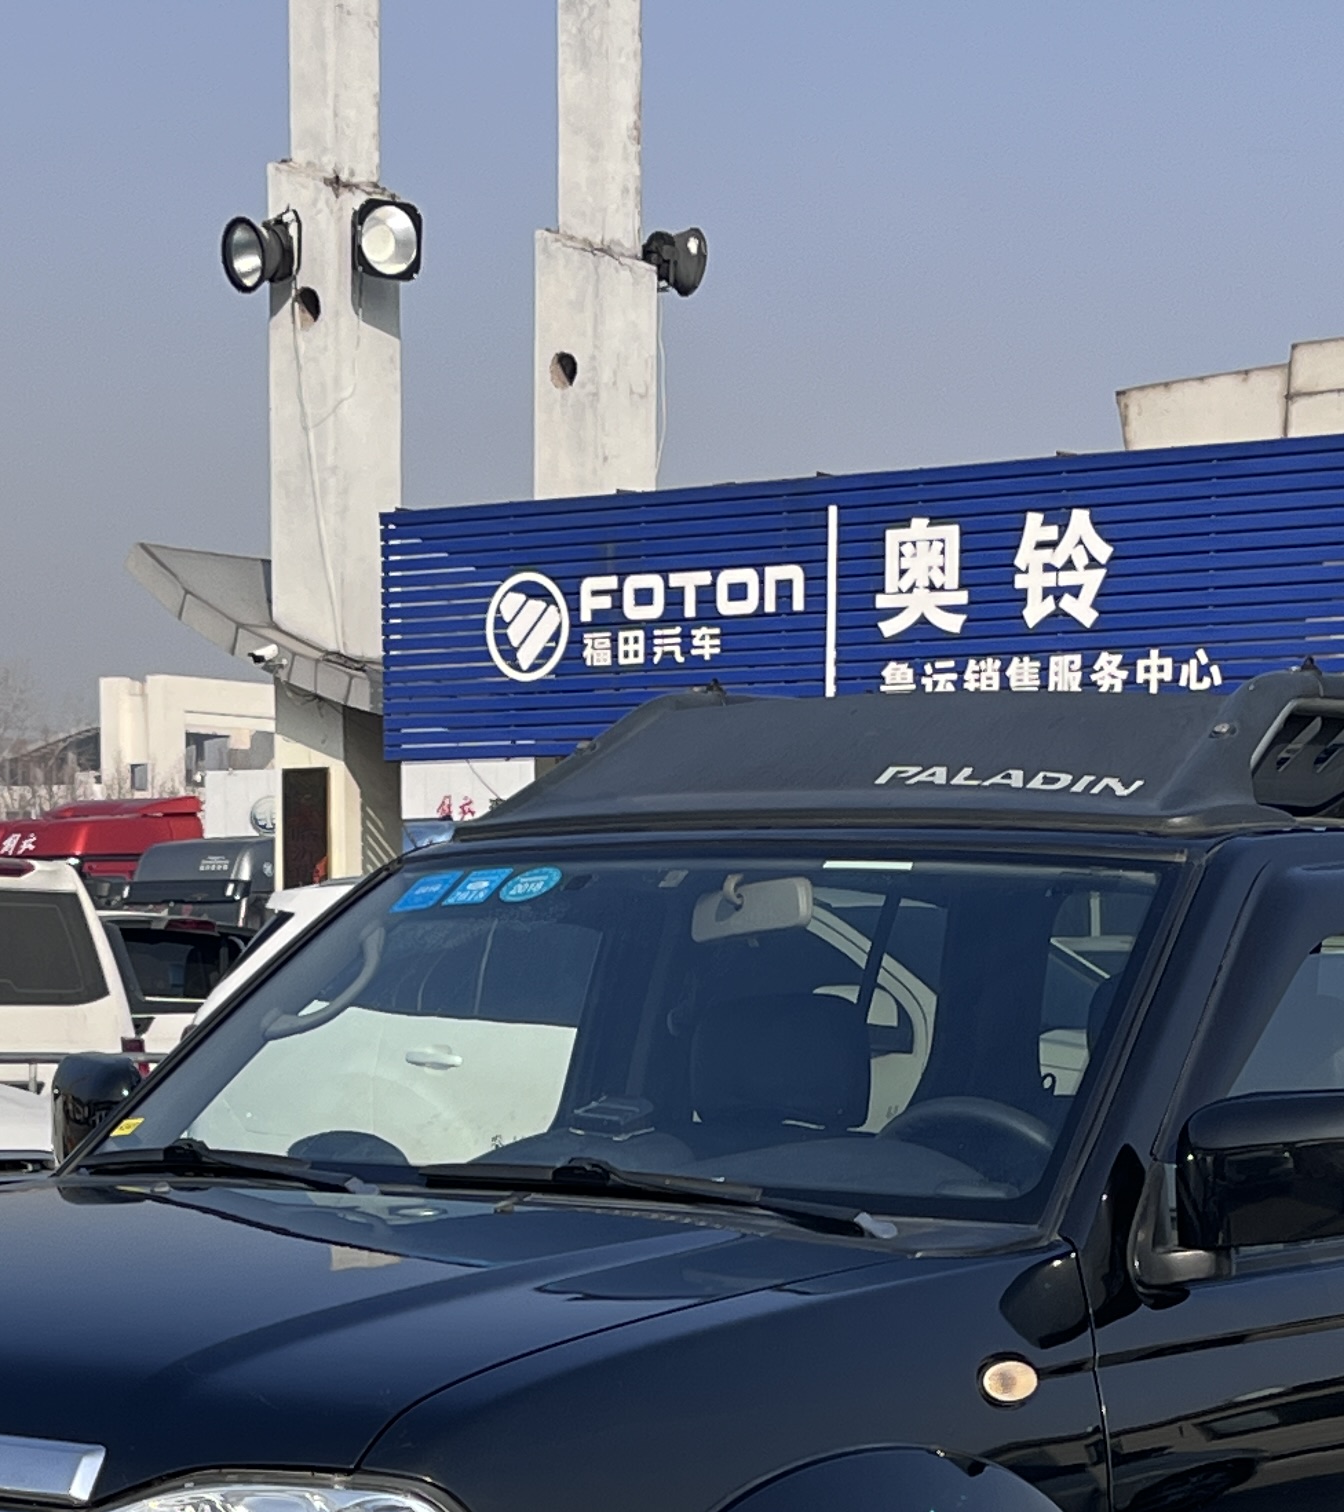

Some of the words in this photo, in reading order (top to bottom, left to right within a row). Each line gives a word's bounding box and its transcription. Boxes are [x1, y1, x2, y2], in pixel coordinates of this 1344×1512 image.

[579, 565, 805, 623] FOTON
[875, 508, 1114, 638] 奥铃
[582, 626, 721, 667] 福田汽车
[873, 765, 1145, 797] PALADIN
